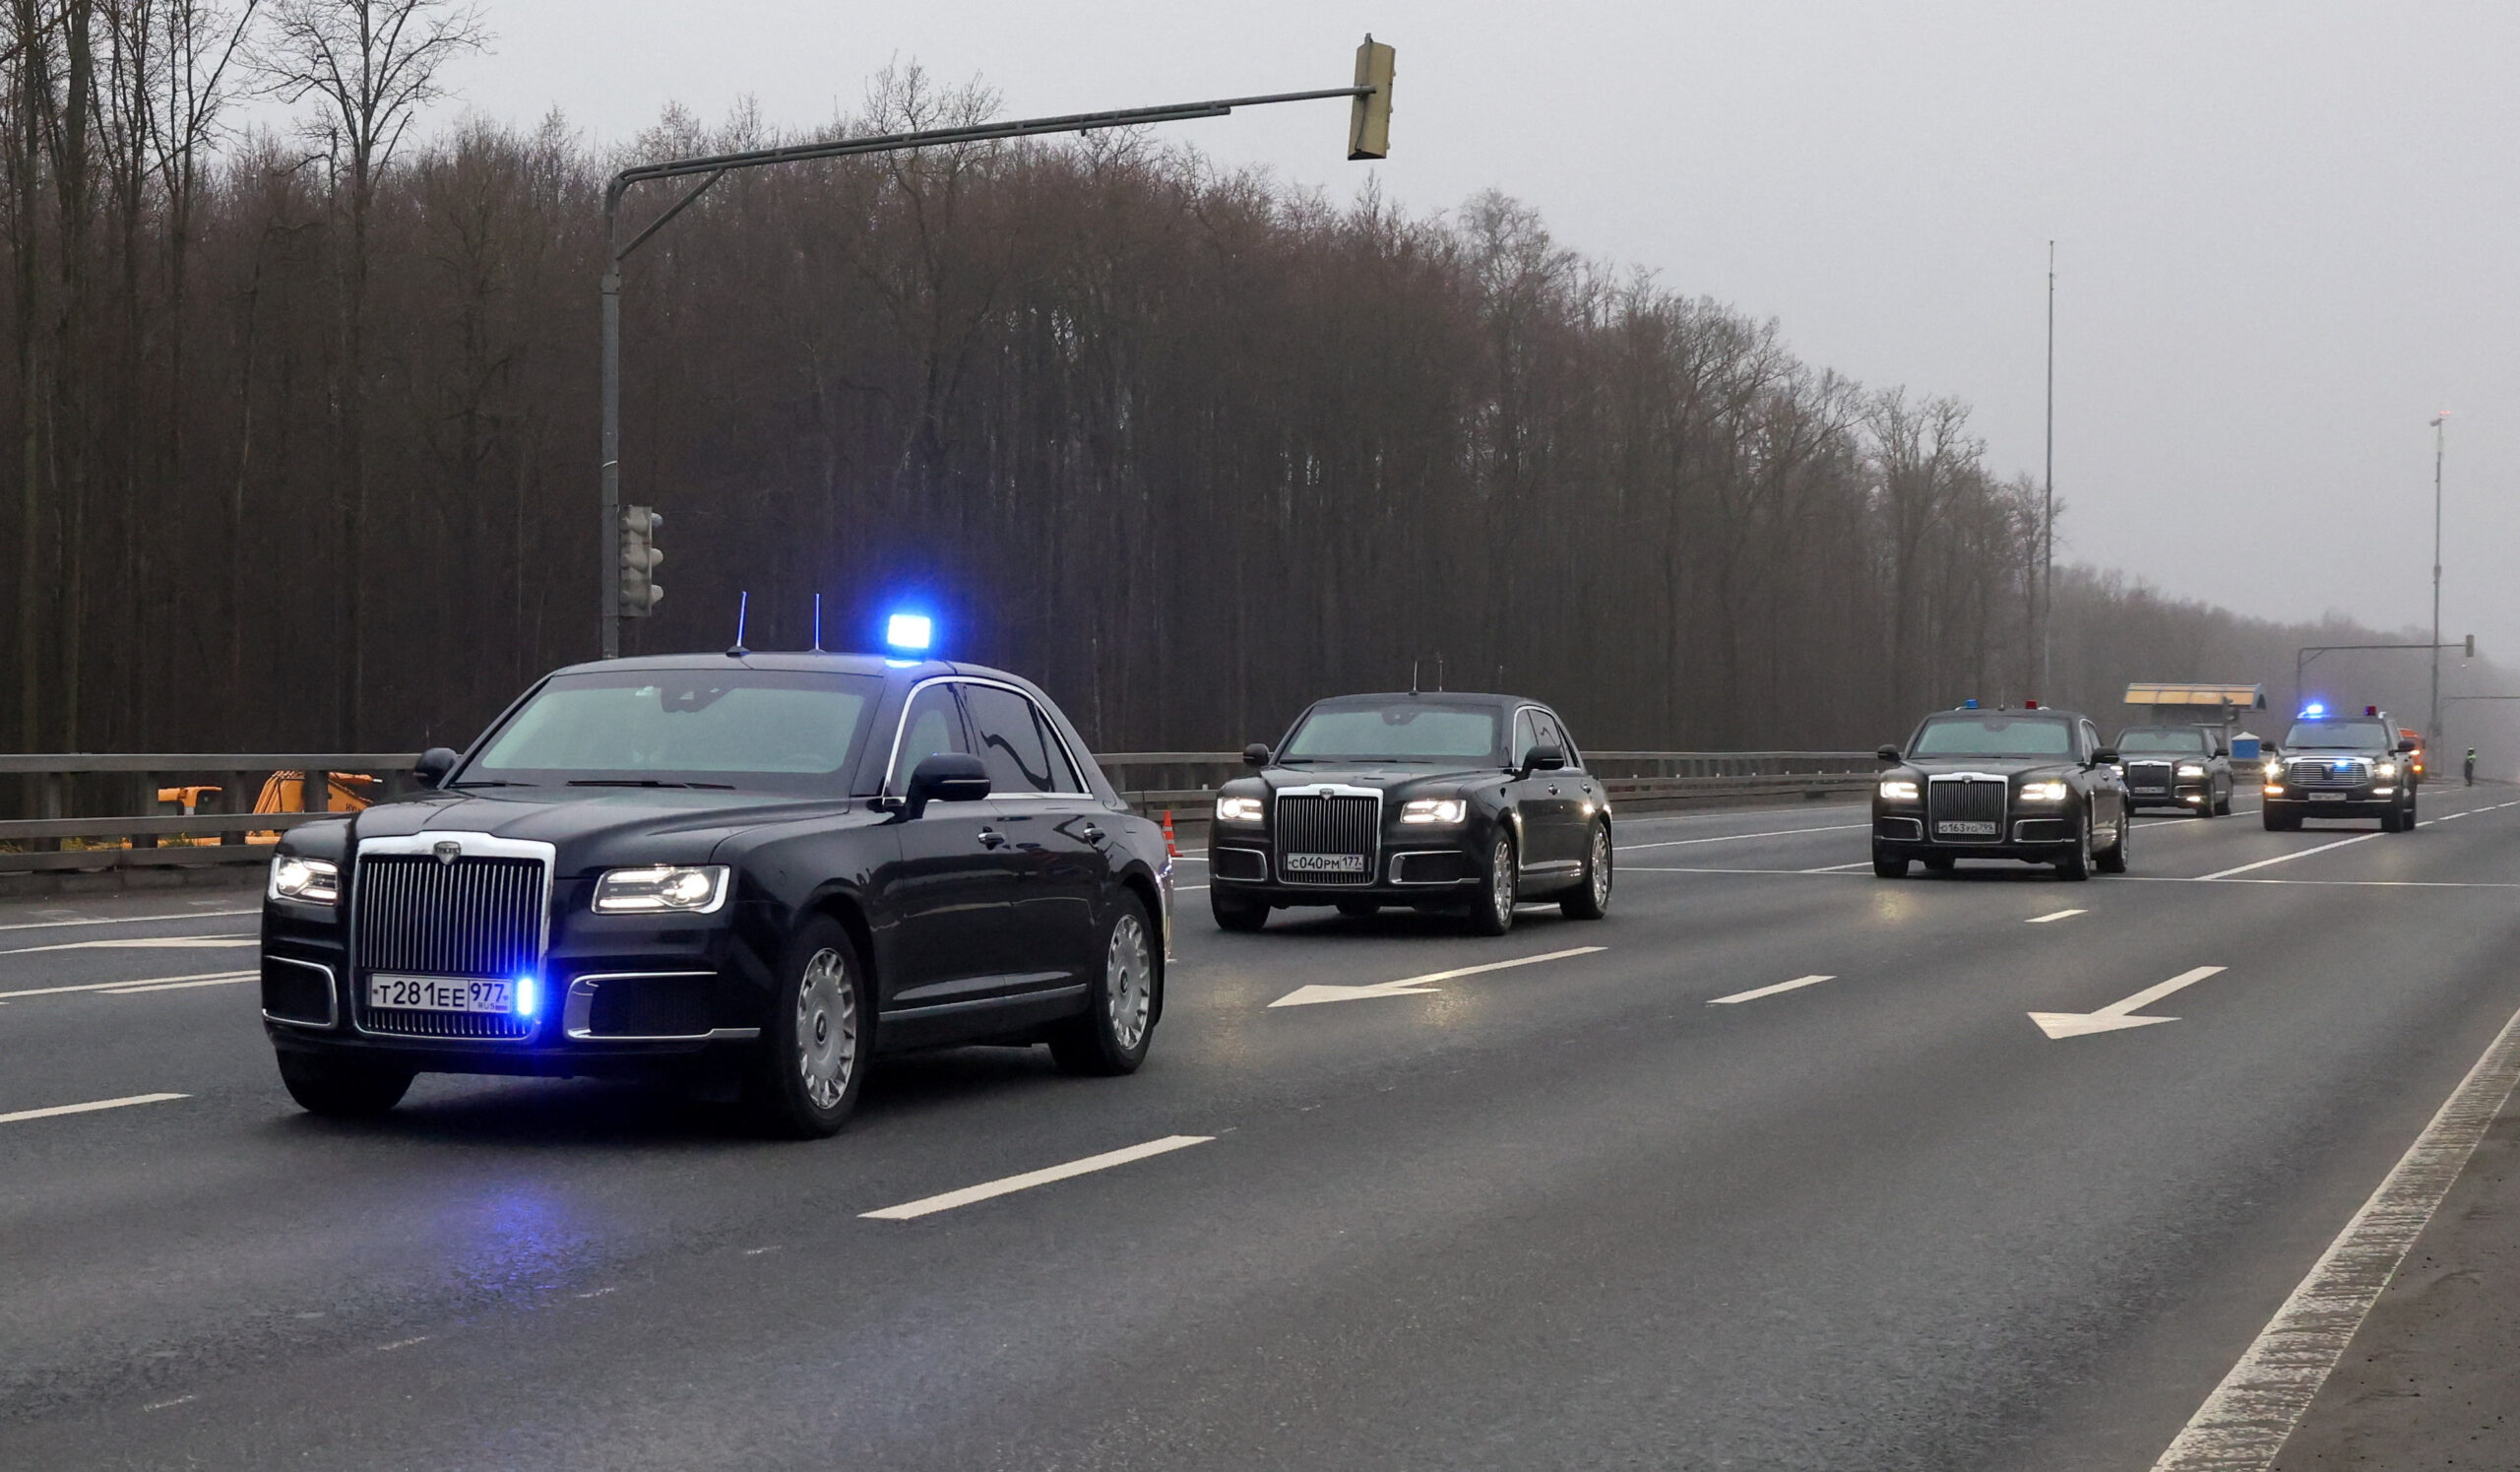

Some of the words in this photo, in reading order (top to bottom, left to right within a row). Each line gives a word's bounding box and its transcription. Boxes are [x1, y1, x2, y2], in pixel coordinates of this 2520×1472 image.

[1342, 857, 1359, 866] 177
[379, 981, 465, 1007] Т281ЕЕ
[470, 983, 504, 1002] 977
[477, 1001, 495, 1010] RUS
